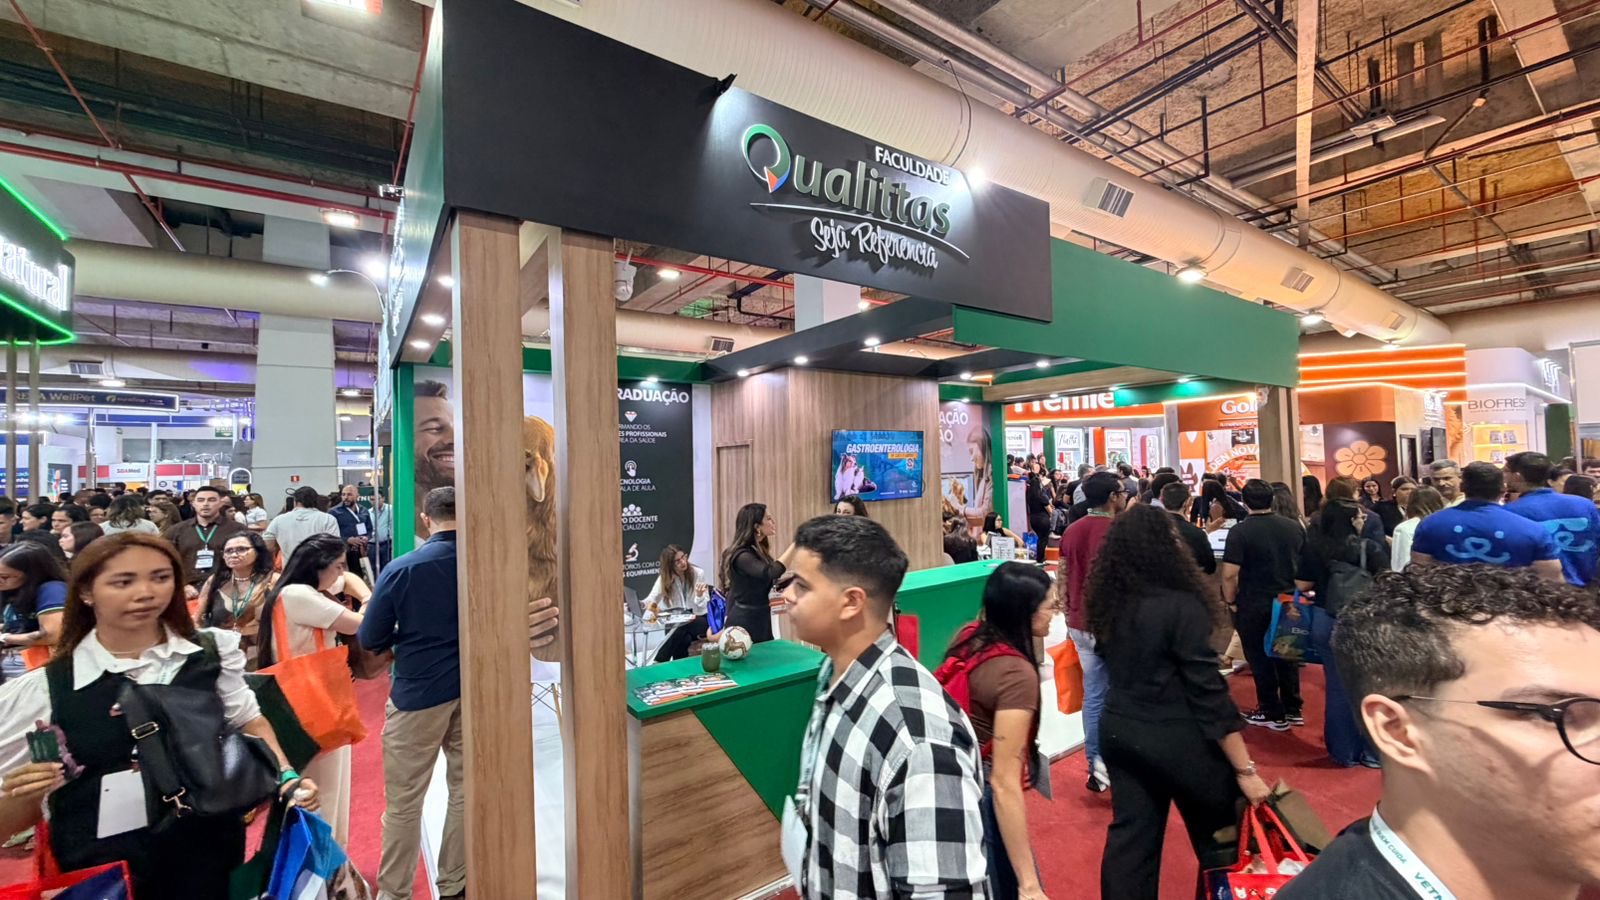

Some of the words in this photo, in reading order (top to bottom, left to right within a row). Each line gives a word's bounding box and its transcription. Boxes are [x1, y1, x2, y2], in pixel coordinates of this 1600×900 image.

[741, 123, 952, 235] Qualittas
[875, 146, 950, 186] FACULDADE
[810, 217, 850, 258] Seja
[0, 236, 70, 311] atural
[1468, 398, 1527, 409] BIOFRES
[846, 444, 919, 453] GASTROENTEROLOGIA
[628, 515, 658, 523] DOCENTE
[1387, 844, 1407, 864] CUIDA
